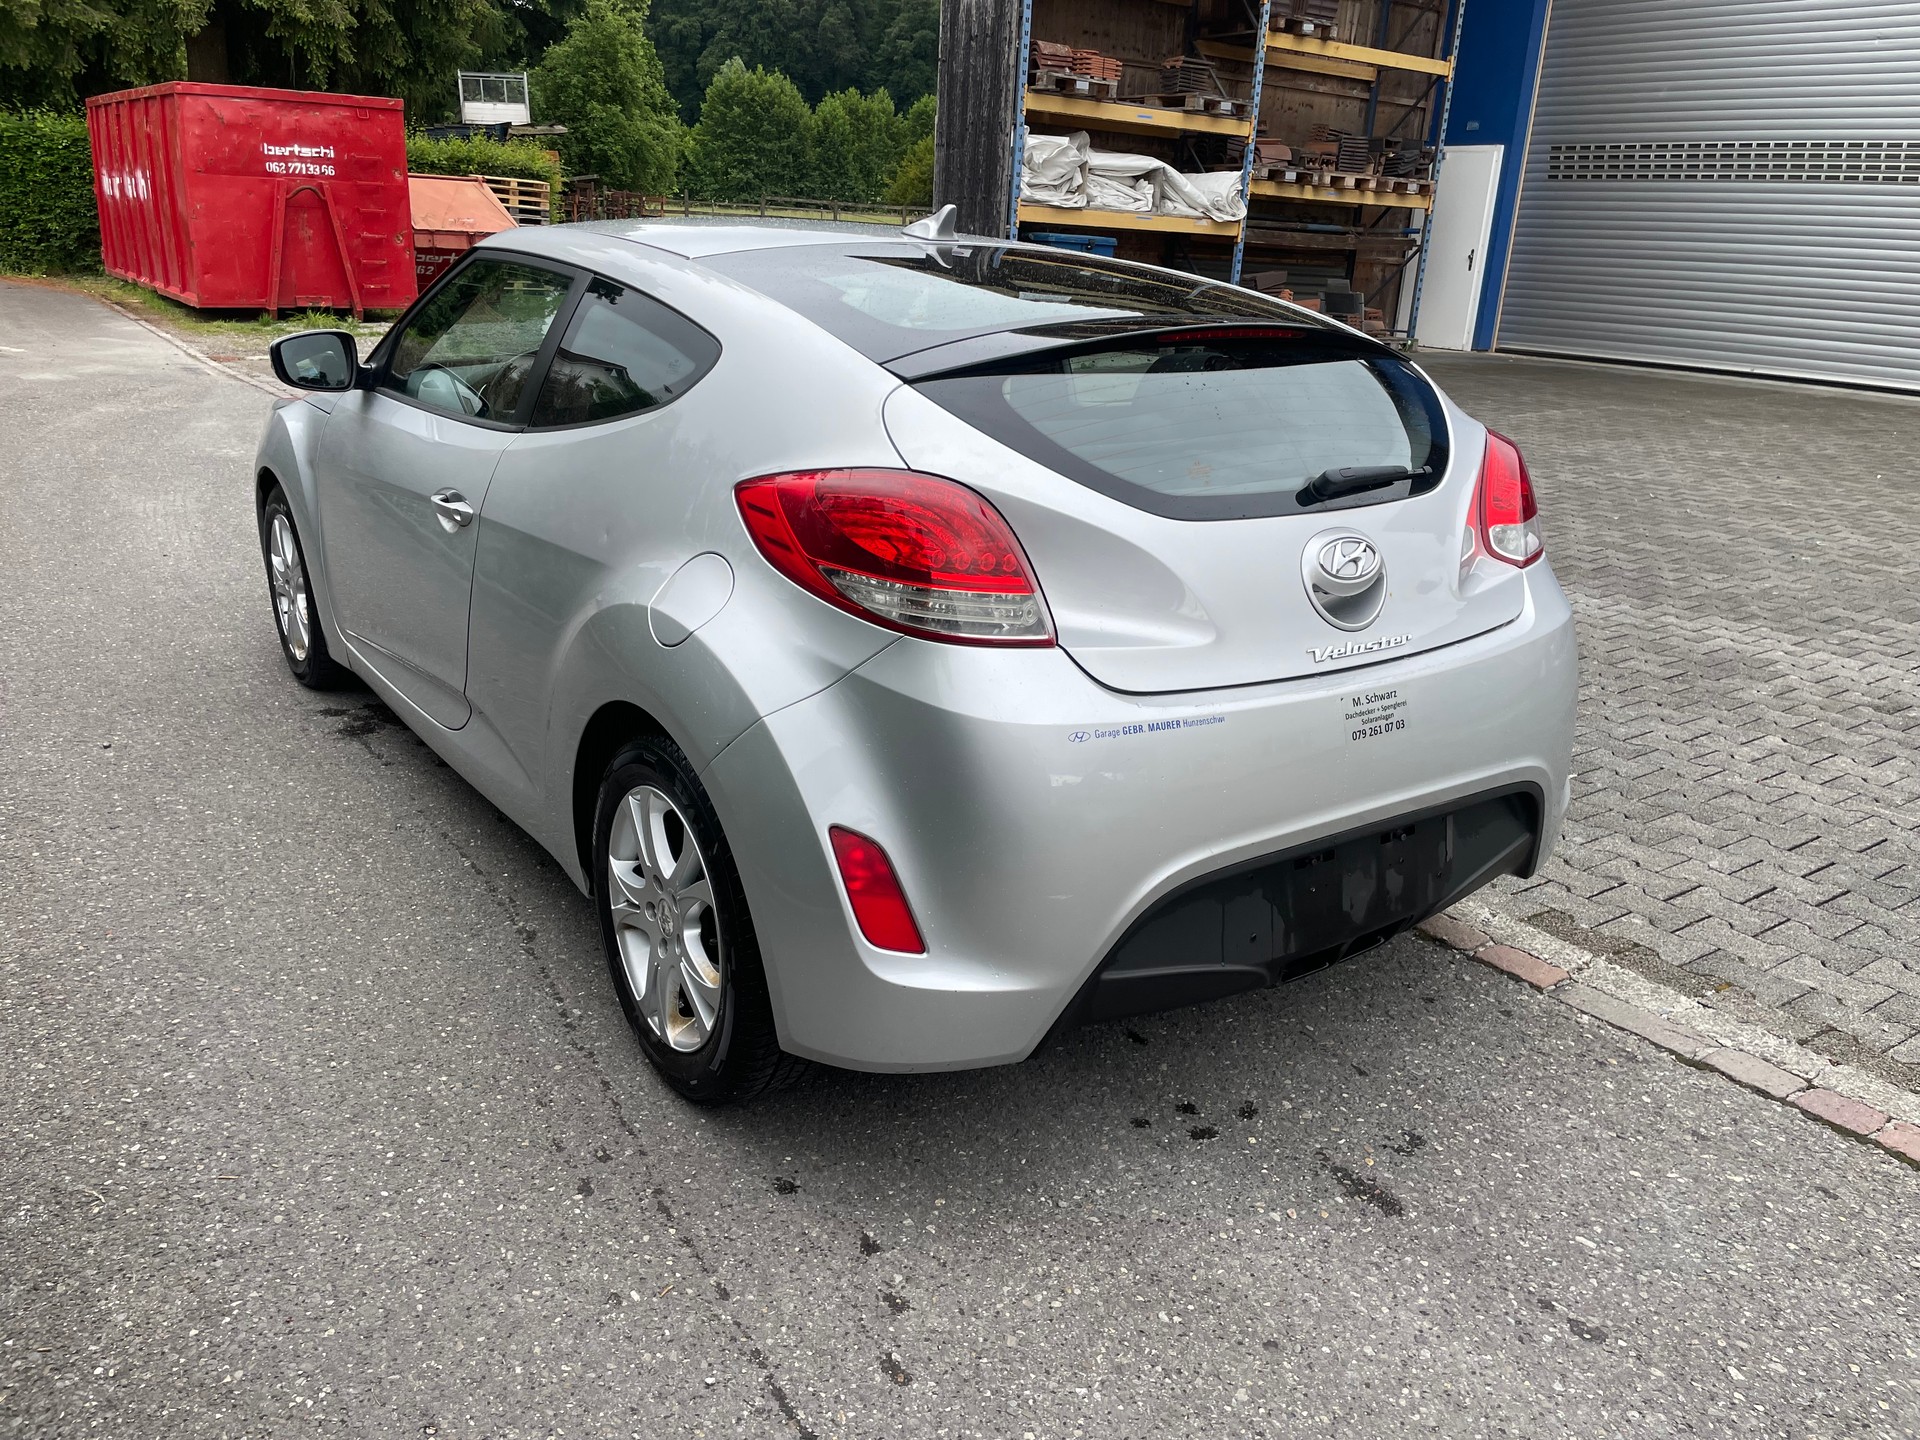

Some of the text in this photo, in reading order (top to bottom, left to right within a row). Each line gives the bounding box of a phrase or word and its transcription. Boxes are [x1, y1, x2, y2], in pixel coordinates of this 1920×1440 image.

[263, 142, 335, 158] bertschi
[265, 161, 286, 174] 062
[415, 265, 435, 275] 62
[1306, 633, 1412, 663] Veloster
[1352, 690, 1398, 707] M. Schwarz
[1345, 708, 1376, 720] Dachdecker
[1381, 699, 1408, 712] Spenglerei
[1361, 712, 1395, 725] Solaranlagen
[1094, 729, 1121, 739] Garage
[1122, 724, 1146, 736] GEBR.
[1148, 719, 1181, 733] MAURER
[1352, 719, 1406, 741] 079 261 07 03
